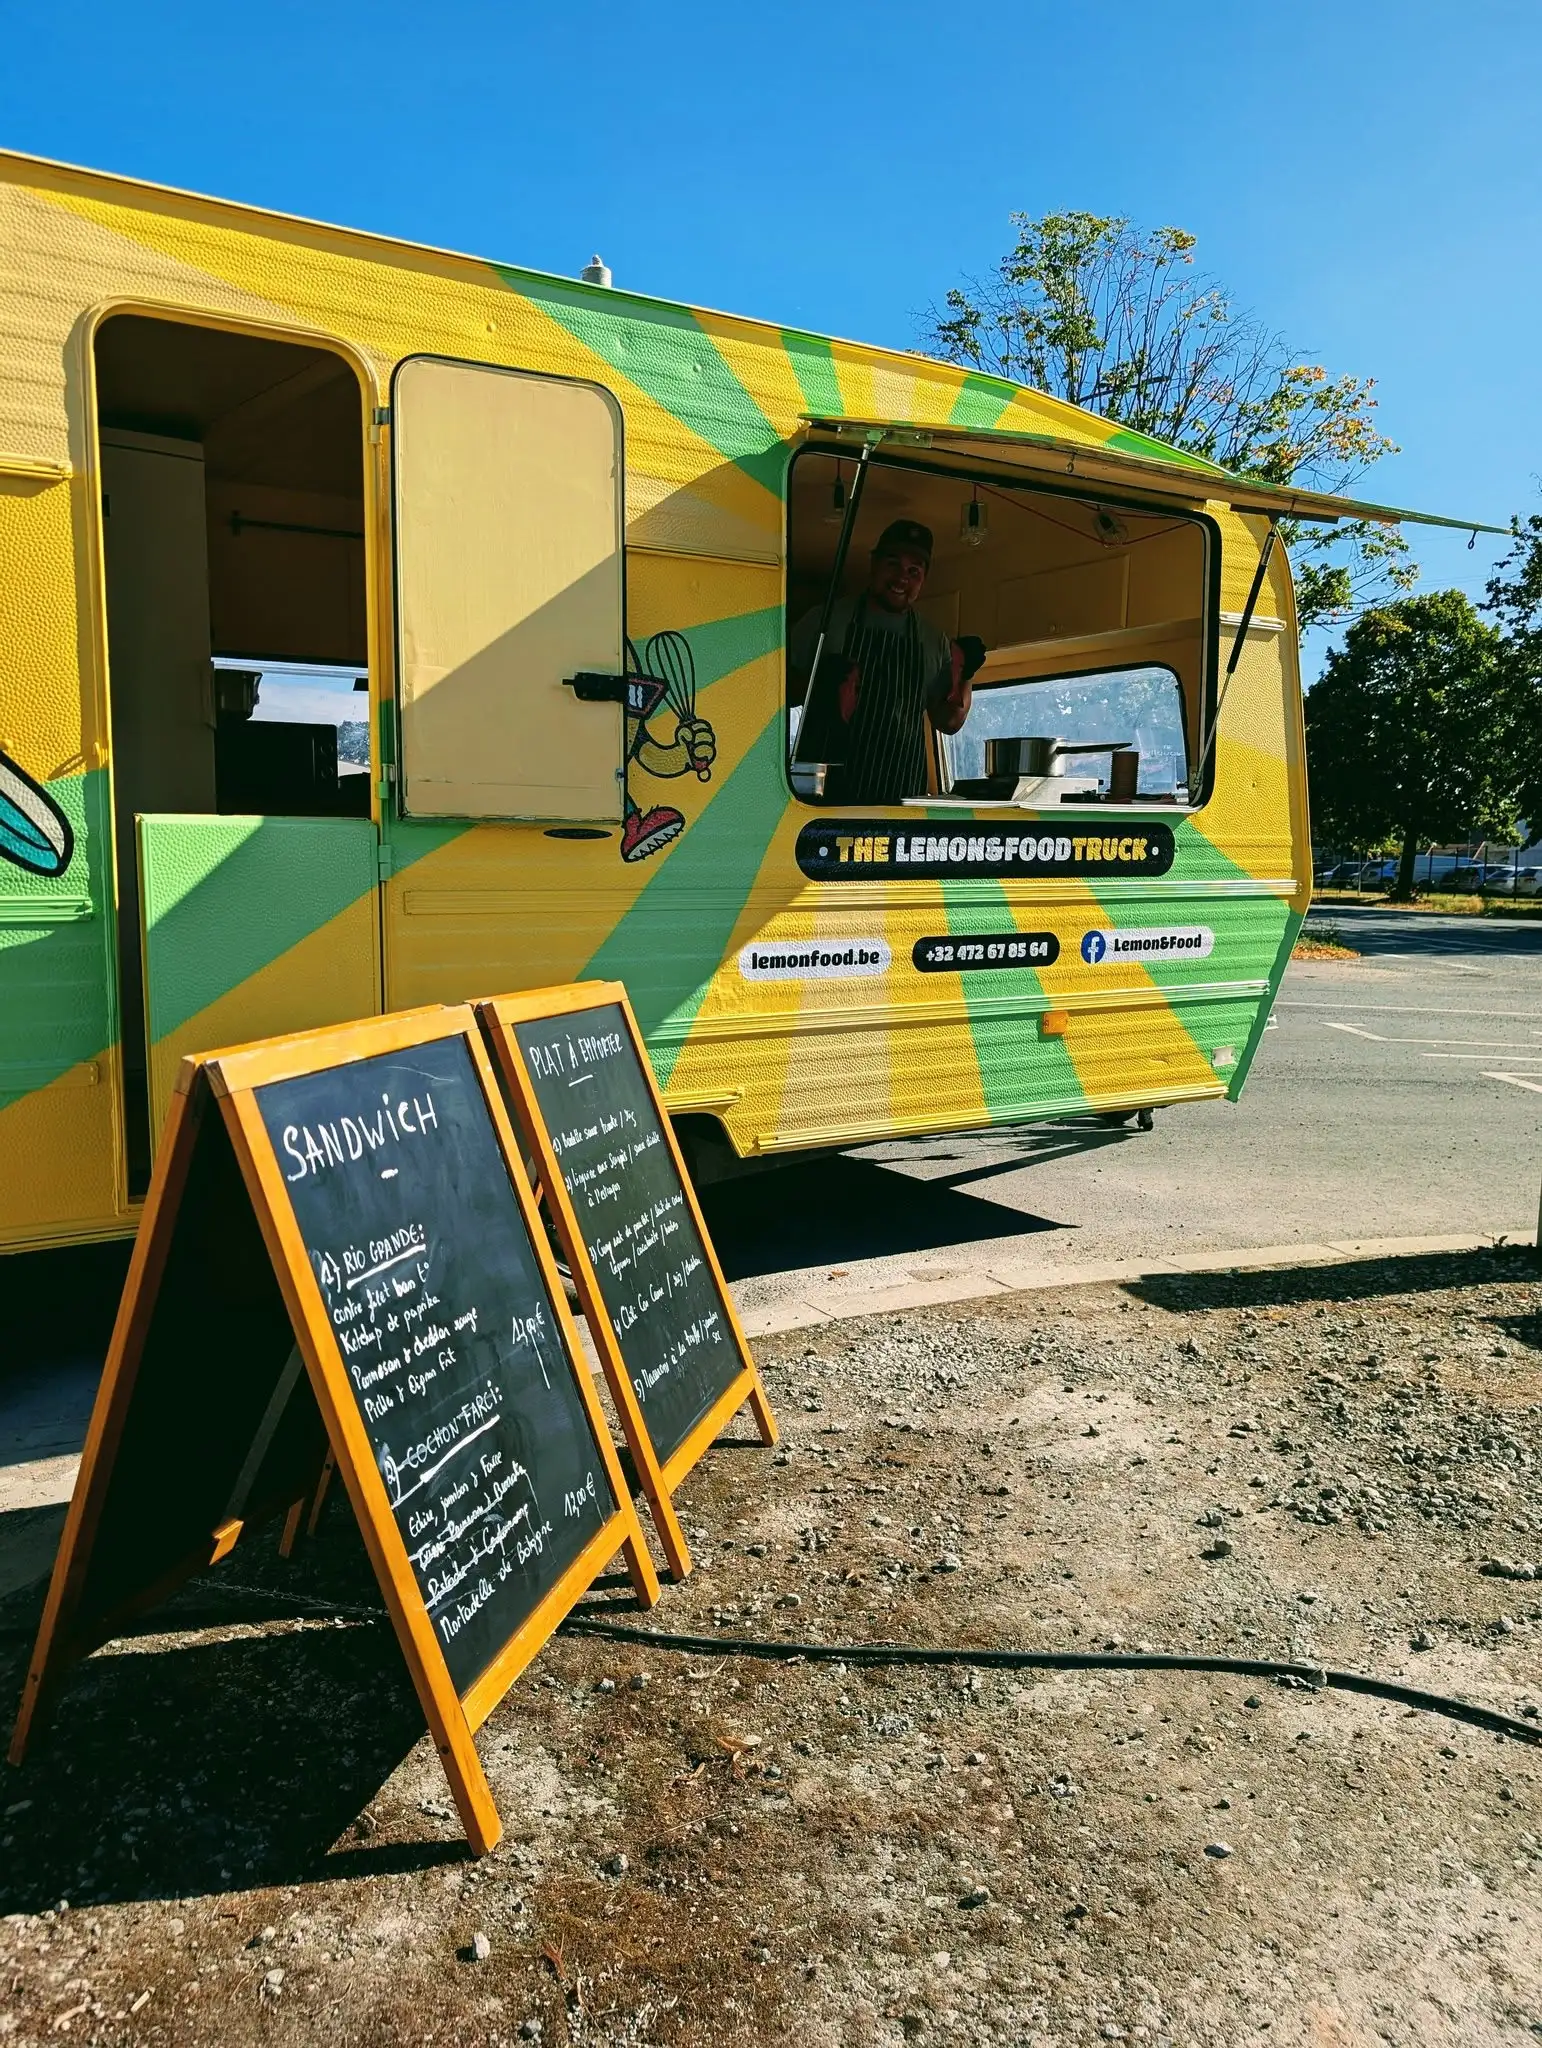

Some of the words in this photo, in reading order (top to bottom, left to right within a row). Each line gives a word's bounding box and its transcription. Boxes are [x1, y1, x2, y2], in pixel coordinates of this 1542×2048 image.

[836, 837, 890, 863] THE
[926, 946, 953, 962] +32
[957, 944, 984, 960] 472
[987, 943, 1005, 959] 67
[1008, 943, 1026, 958] 85
[1030, 941, 1049, 957] 64
[1114, 934, 1202, 952] Lemon&Food
[751, 949, 880, 970] lemonfood.be
[529, 1043, 565, 1080] PLAT
[565, 1034, 579, 1069] À
[577, 1032, 624, 1063] EMPORTER
